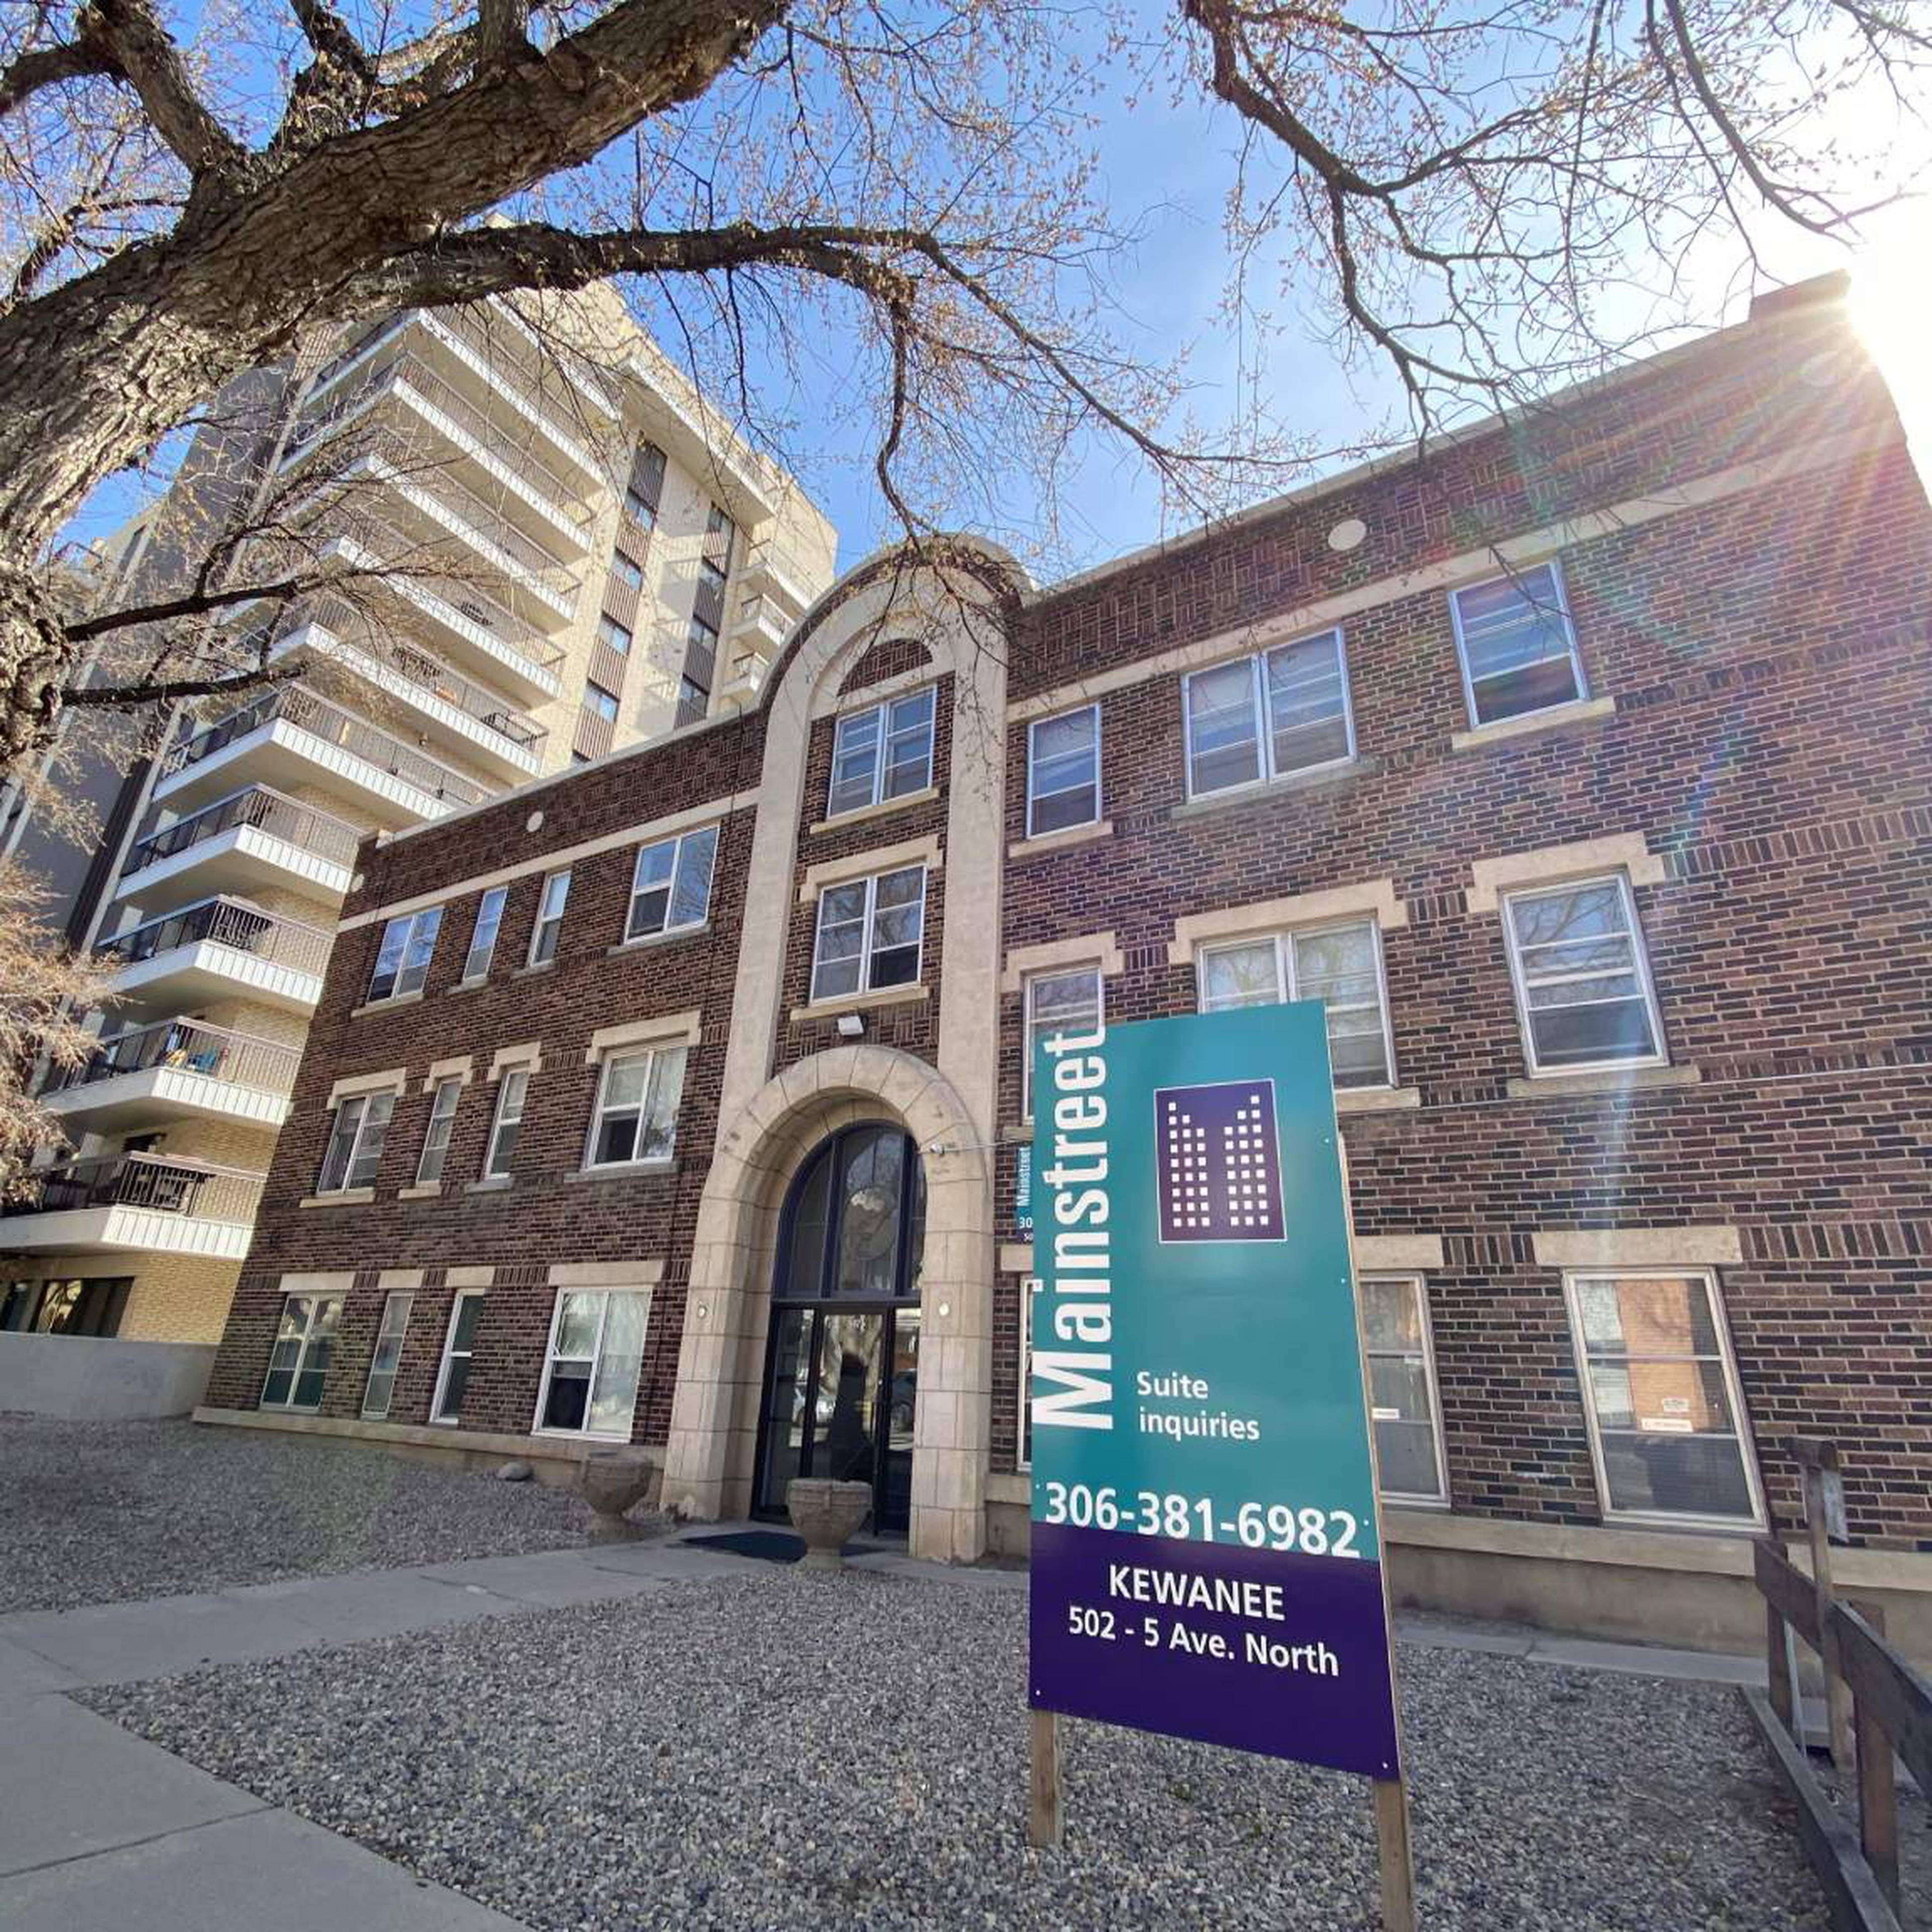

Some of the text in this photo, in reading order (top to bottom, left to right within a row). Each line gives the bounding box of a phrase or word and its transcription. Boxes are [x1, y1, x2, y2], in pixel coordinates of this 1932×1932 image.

[1016, 1146, 1031, 1206] Mainstreet
[1032, 1026, 1113, 1429] Mainstreet
[1137, 1372, 1209, 1399] Suite
[1140, 1408, 1260, 1441] inquiries
[1045, 1482, 1360, 1559] 306-381-6982
[1109, 1565, 1285, 1621] KEWANEE
[1069, 1606, 1116, 1640] 502
[1145, 1618, 1159, 1647] 5
[1169, 1623, 1235, 1660] Ave.
[1246, 1633, 1339, 1676] North
